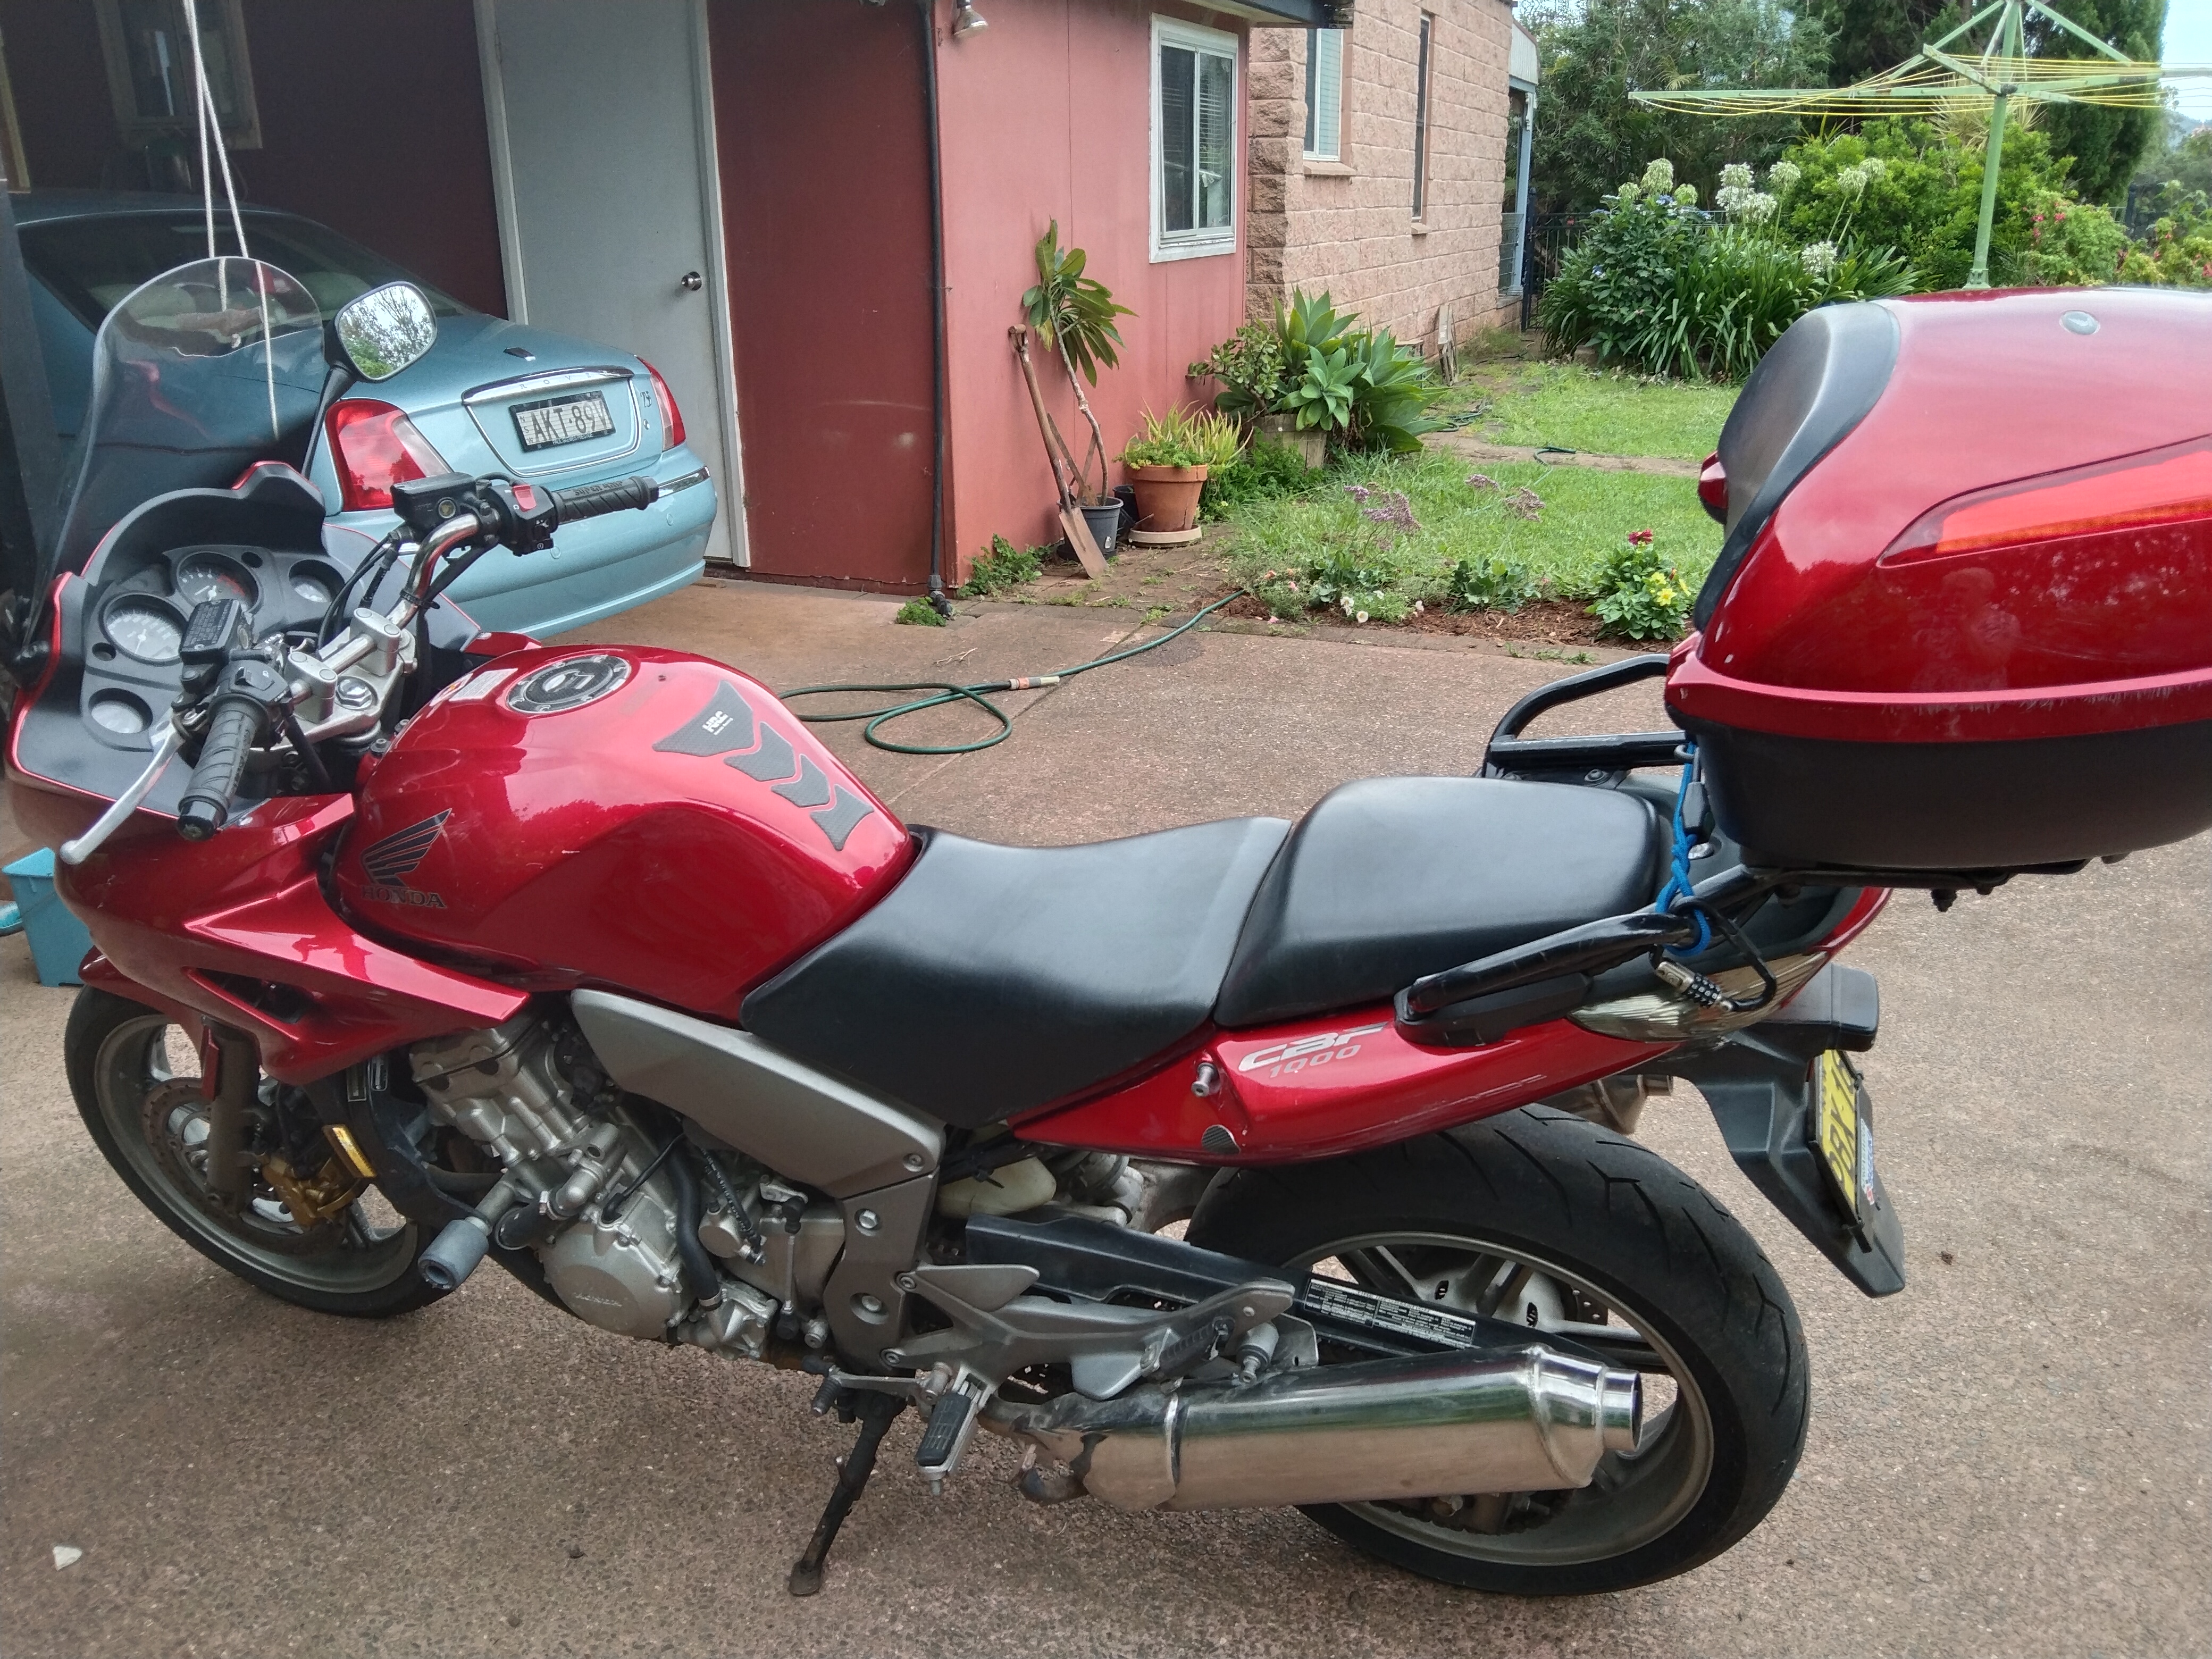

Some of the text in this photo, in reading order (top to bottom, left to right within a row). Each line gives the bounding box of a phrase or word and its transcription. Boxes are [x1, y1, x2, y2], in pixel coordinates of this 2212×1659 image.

[361, 884, 447, 909] HONDA
[1238, 1021, 1388, 1072] CBF
[1269, 1045, 1361, 1078] 1000
